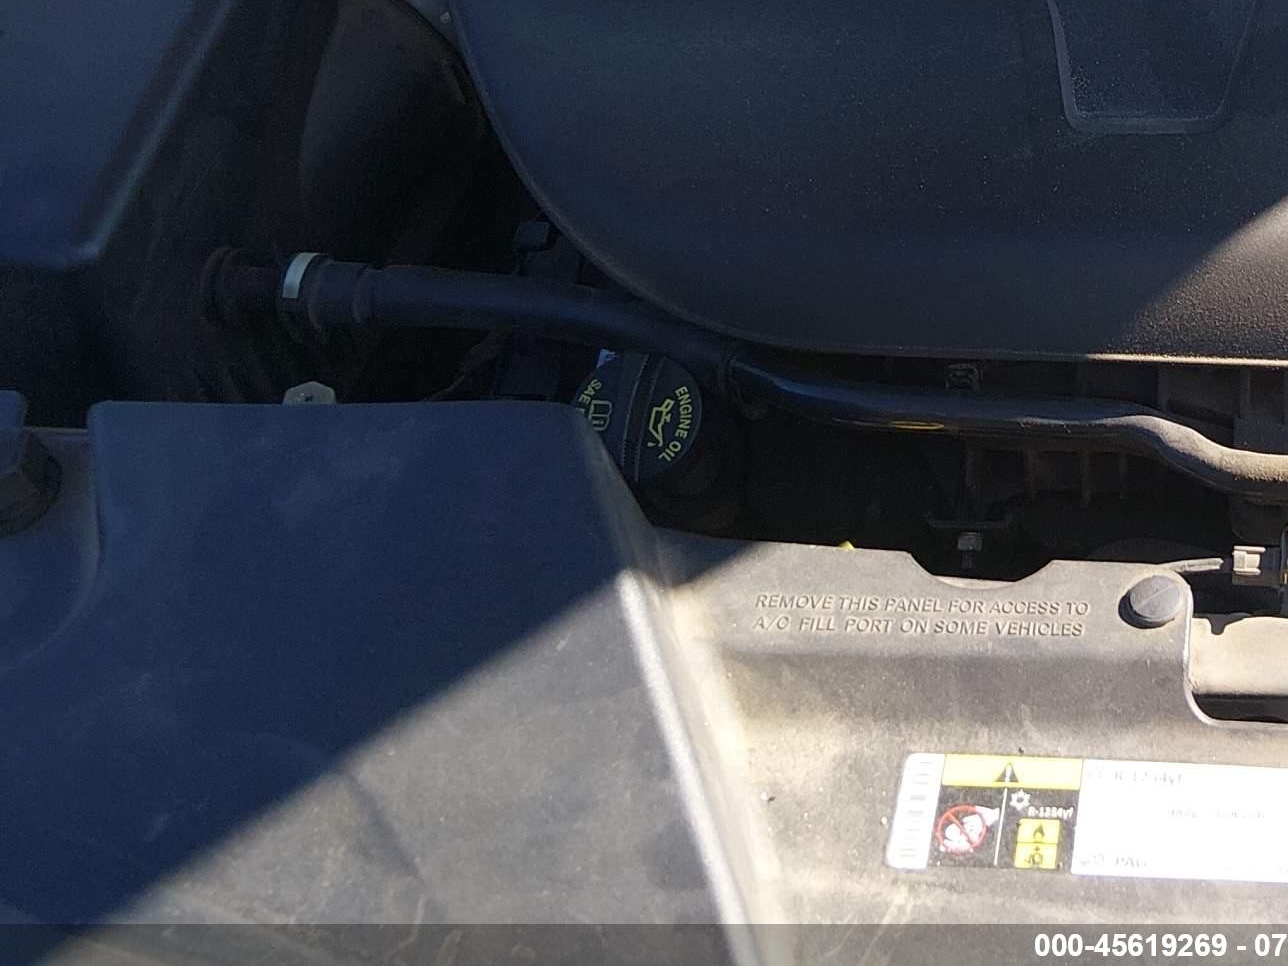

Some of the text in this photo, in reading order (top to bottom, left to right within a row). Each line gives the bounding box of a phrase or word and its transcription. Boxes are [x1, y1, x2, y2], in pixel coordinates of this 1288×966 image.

[578, 378, 602, 405] SAE
[658, 386, 693, 462] ENGINE OIL
[755, 594, 1089, 616] REMOVE THIS PANEL FOR ACCESS TO
[753, 616, 1083, 637] A/C FILL PORT ON SOME VEHICLES
